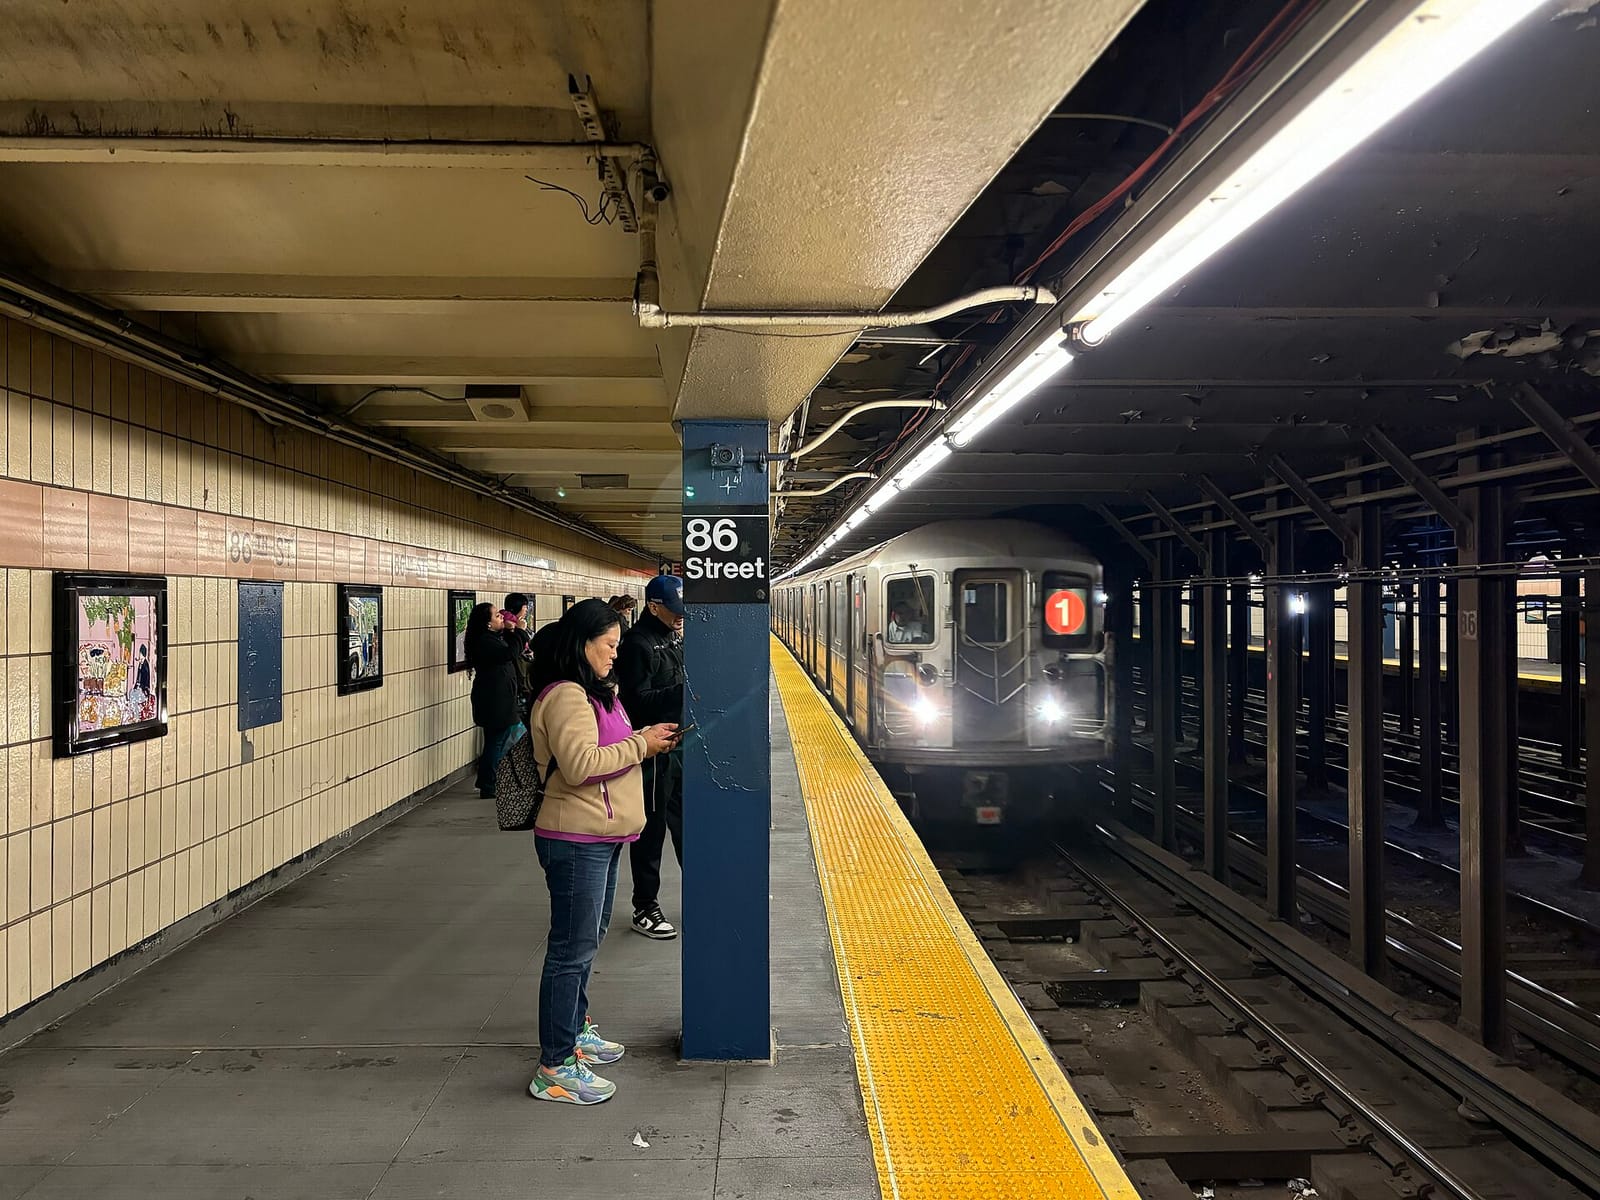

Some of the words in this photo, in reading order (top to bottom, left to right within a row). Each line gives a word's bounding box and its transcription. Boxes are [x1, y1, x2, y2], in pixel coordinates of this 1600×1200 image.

[685, 518, 739, 552] 86
[685, 556, 765, 579] Street
[1055, 598, 1069, 626] 1
